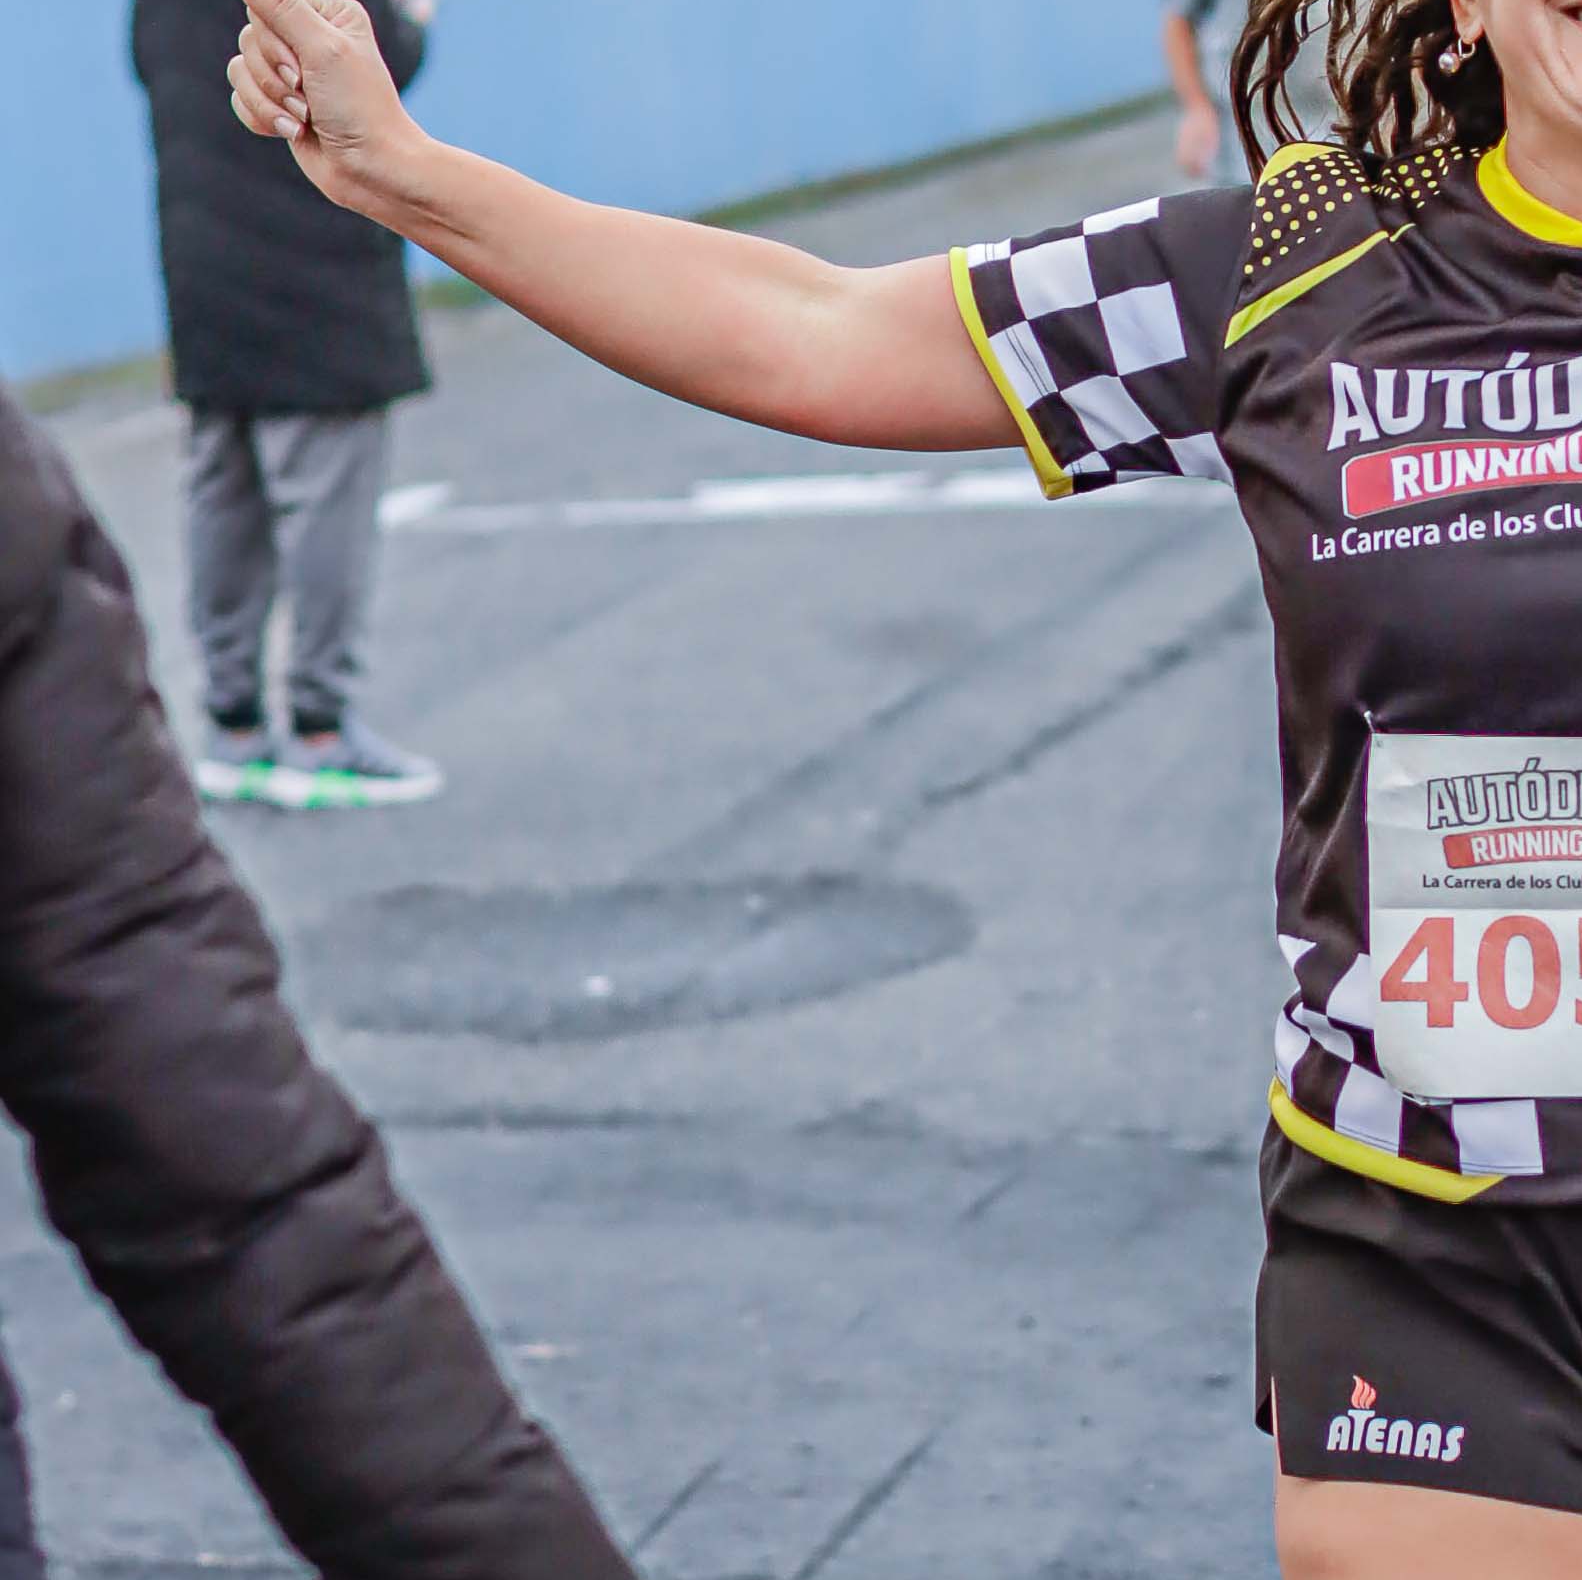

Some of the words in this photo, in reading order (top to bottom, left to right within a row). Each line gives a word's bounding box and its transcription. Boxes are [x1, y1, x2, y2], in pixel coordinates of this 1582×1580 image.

[1310, 533, 1337, 562] La
[1340, 524, 1440, 556] Carrera
[1448, 511, 1487, 543] de
[1493, 508, 1537, 539] los
[1422, 874, 1440, 889] La
[1443, 874, 1501, 889] Carrera
[1506, 874, 1526, 889] de
[1529, 874, 1552, 889] los
[1326, 1408, 1465, 1462] ATENAS
